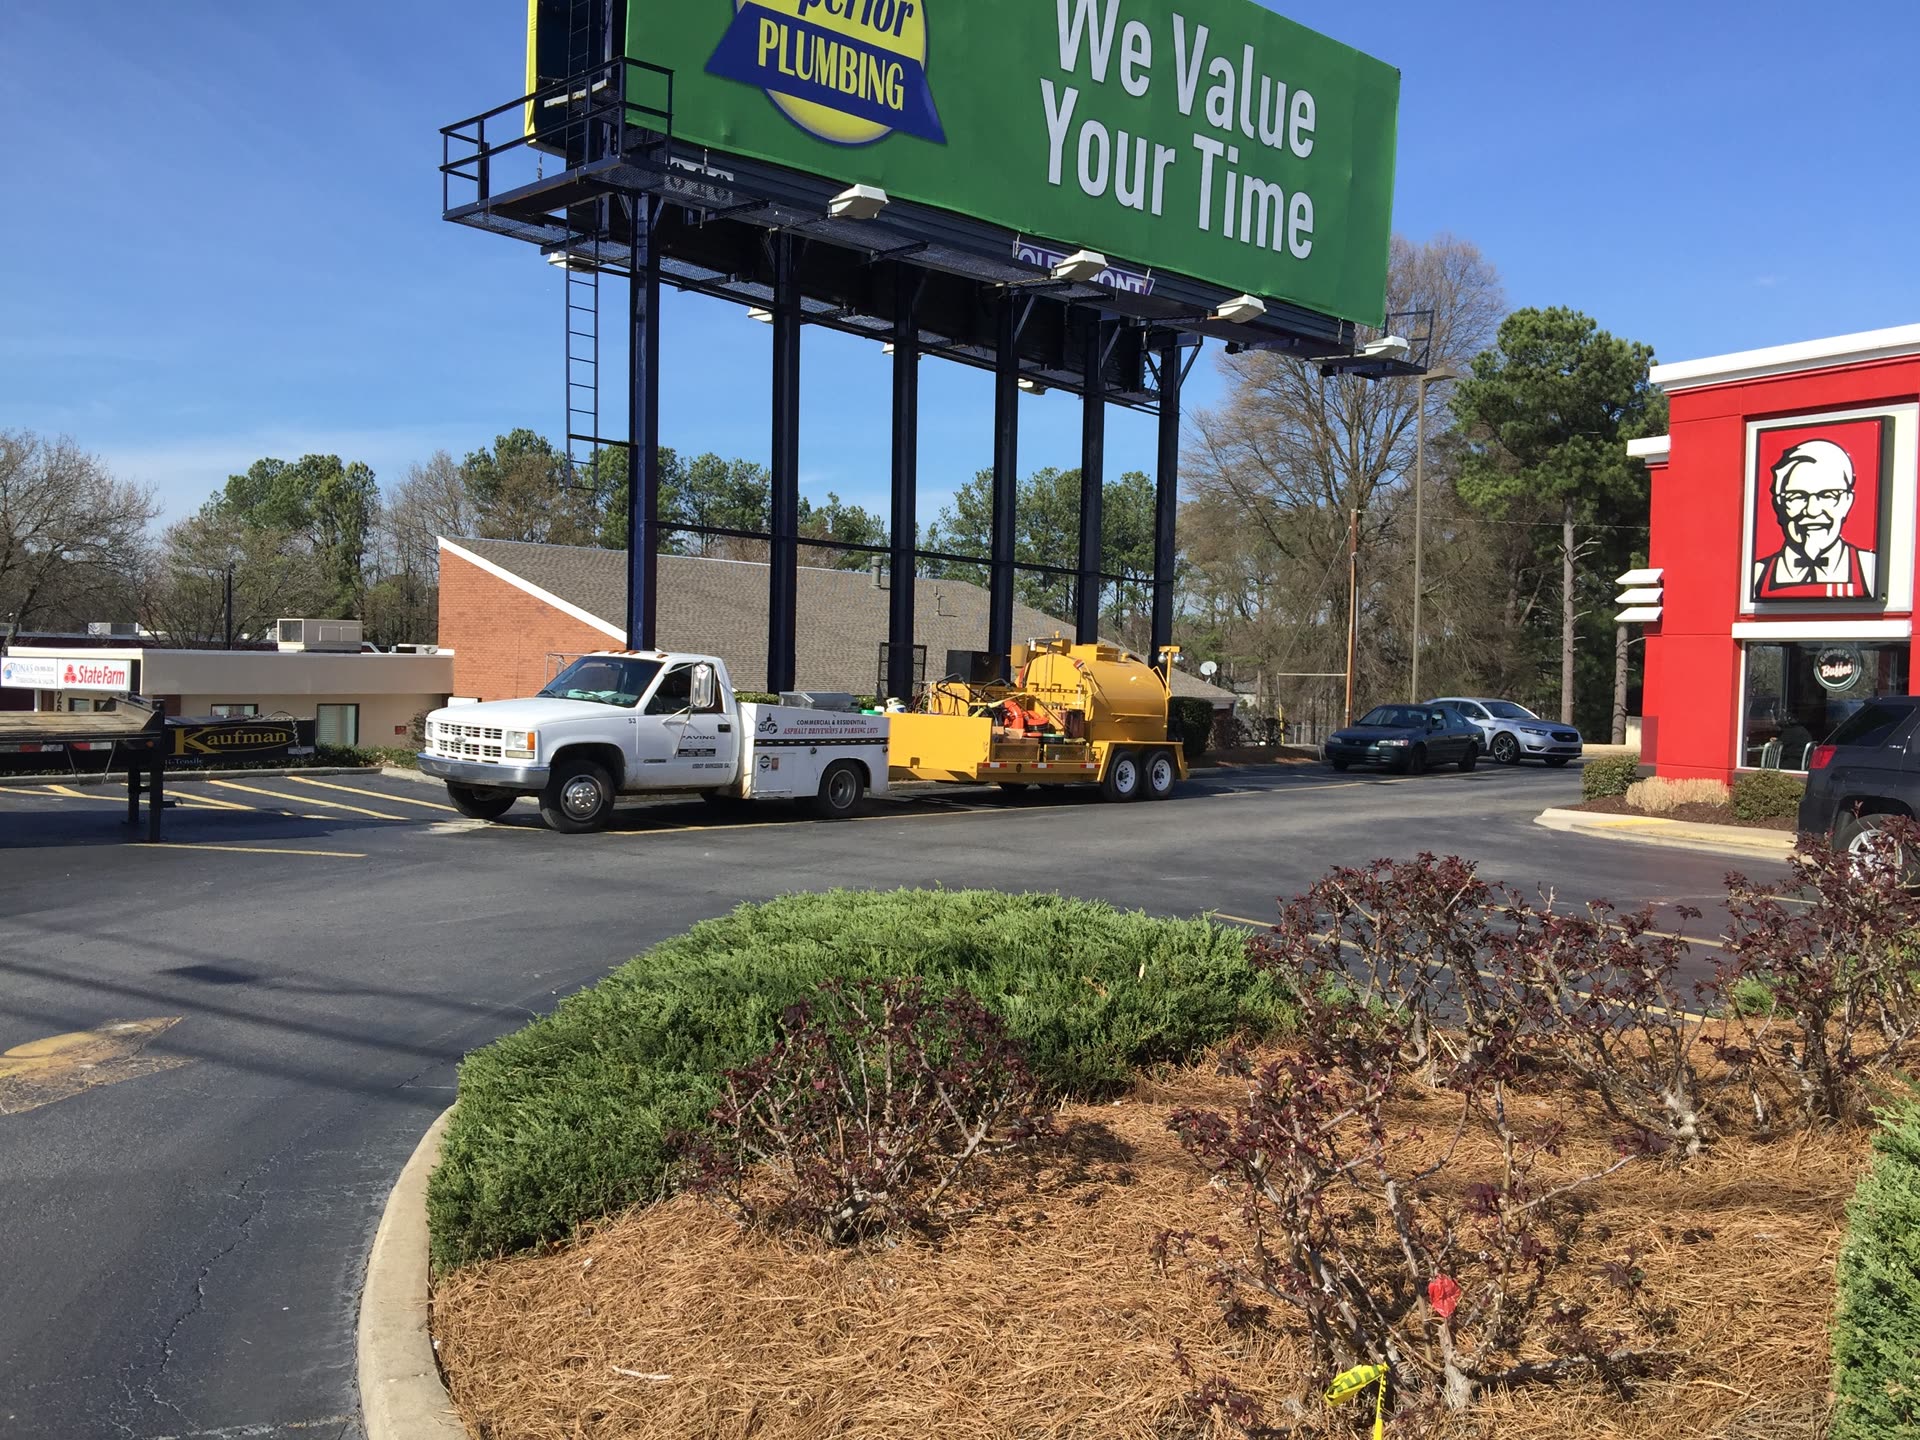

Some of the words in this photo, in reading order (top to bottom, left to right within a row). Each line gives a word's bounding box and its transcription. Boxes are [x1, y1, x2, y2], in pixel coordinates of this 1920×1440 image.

[758, 17, 904, 111] PLUMBING
[1056, 0, 1152, 97] We
[1172, 12, 1316, 159] Value
[1040, 77, 1176, 216] Your
[1193, 133, 1314, 260] Time
[1821, 661, 1852, 678] Buffet
[168, 726, 288, 756] Kaufman
[783, 727, 808, 735] ASPHALT
